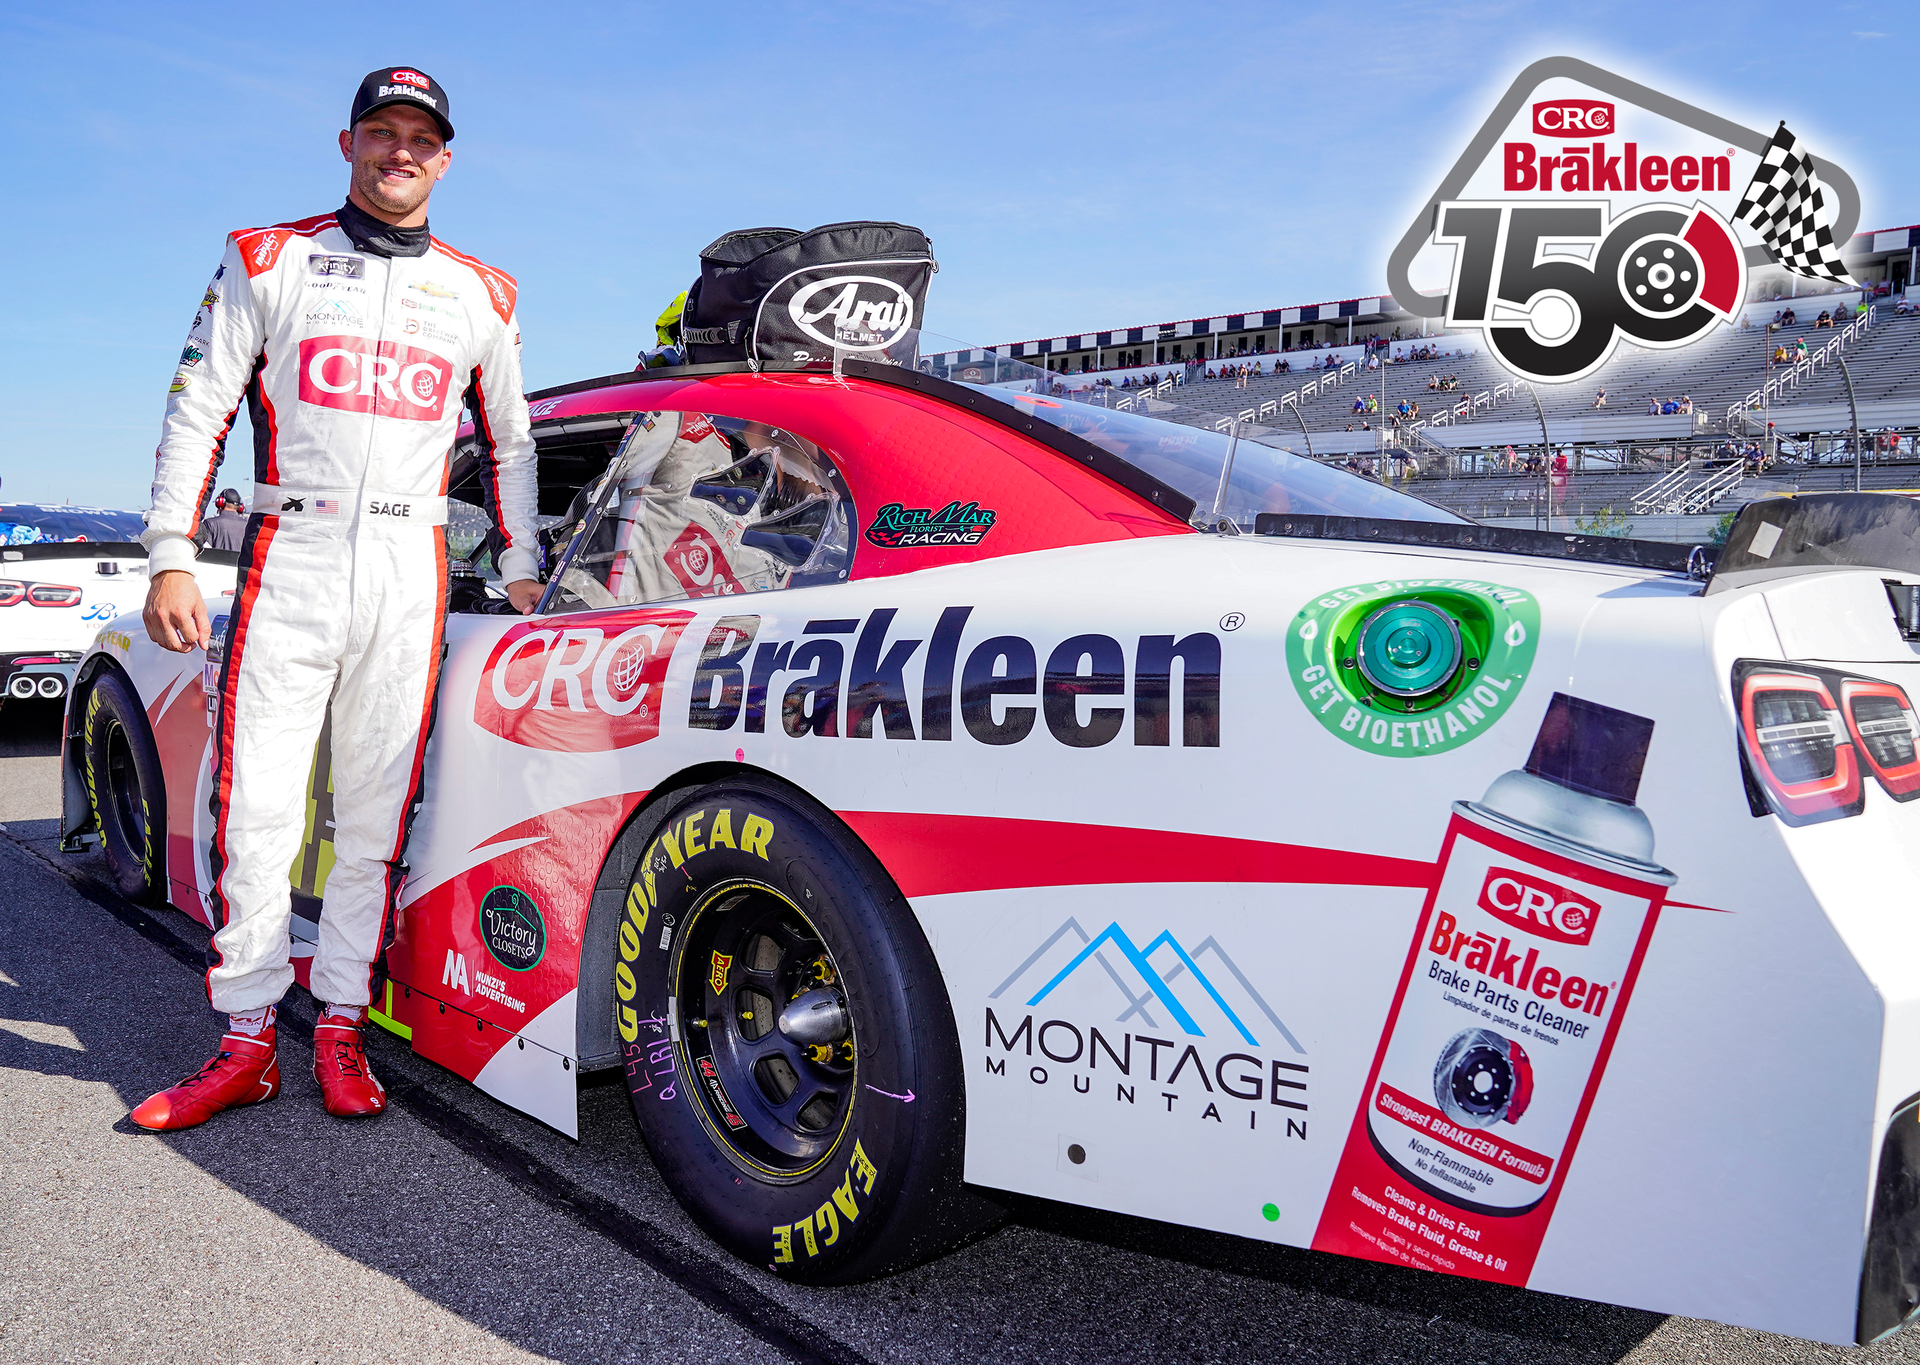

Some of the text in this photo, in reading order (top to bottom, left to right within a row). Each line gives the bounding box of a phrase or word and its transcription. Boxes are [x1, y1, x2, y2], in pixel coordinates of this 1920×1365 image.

[393, 71, 427, 88] CRC
[255, 233, 277, 267] IMPACT
[318, 261, 355, 275] xfinity
[304, 280, 366, 294] GOODYEAR
[306, 312, 364, 326] MONTAGE
[798, 283, 905, 332] Arai
[422, 332, 455, 346] COMPANY
[423, 321, 437, 329] THE
[423, 327, 459, 341] DRIVEWAY
[836, 330, 882, 342] HELMET
[308, 347, 443, 408] CRC
[530, 400, 563, 417] AGE
[369, 501, 411, 517] SAGE
[874, 503, 993, 531] RICH MAR
[898, 532, 982, 545] RACING
[910, 525, 945, 533] FLORIST
[1318, 580, 1528, 609] GET BIOETHANOL
[491, 625, 669, 719] CRC
[687, 606, 1223, 748] Brākleen
[1301, 664, 1512, 748] GET BIOETHANOL
[1487, 877, 1591, 935] CRC
[486, 908, 537, 957] Victory
[616, 808, 774, 1043] GOODYEAR
[492, 936, 528, 960] CLOSETS
[1428, 910, 1609, 1018] Brākleen
[475, 970, 506, 992] NUNZI'S
[715, 956, 726, 987] AERO
[475, 983, 526, 1014] ADVERTISING
[1428, 960, 1590, 1039] Brake Parts Cleaner
[1443, 991, 1560, 1046] Limpiador de partes de frenos
[985, 1006, 1310, 1112] MONTAGE
[701, 1059, 716, 1077] 44
[725, 1112, 743, 1126] 45
[986, 1056, 1308, 1142] MOUNTAIN
[1380, 1093, 1546, 1178] Strongest BRAKLEEN Formula
[1407, 1138, 1495, 1186] Non-Flammable
[1414, 1158, 1477, 1194] No Inflamable
[772, 1136, 878, 1264] EAGLE
[1384, 1185, 1482, 1242] Cleans & Dries Fast
[1351, 1185, 1508, 1272] Removes Brake Fluid, Grease & Oil
[1382, 1226, 1406, 1246] Limpia
[1406, 1241, 1413, 1251] y
[1413, 1242, 1431, 1259] seca
[1399, 1249, 1410, 1263] de
